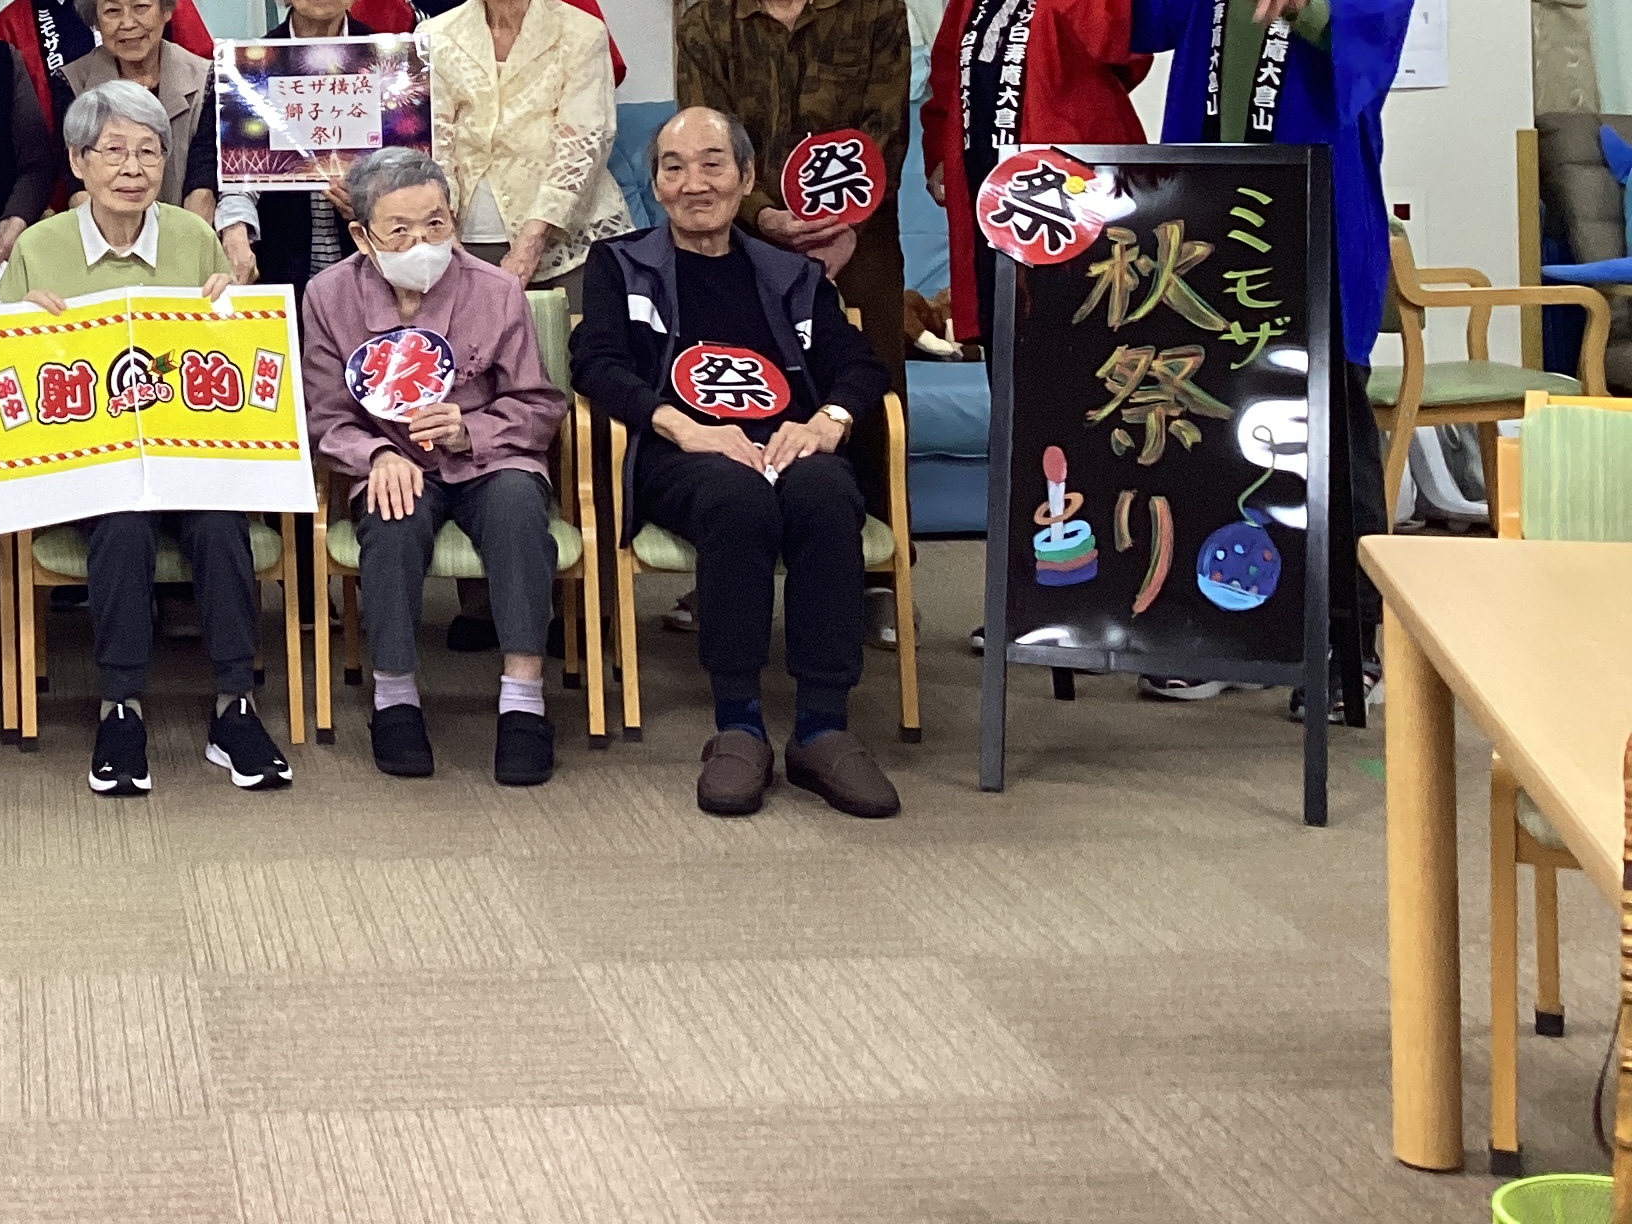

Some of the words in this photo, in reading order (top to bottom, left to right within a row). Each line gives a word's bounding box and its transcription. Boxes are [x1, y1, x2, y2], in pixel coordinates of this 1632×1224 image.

[276, 76, 373, 96] ミモザ横浜
[310, 126, 343, 146] 祭り
[798, 139, 874, 215] 祭
[987, 160, 1079, 255] 祭
[1218, 187, 1292, 370] ミモザ
[254, 355, 278, 402] 的中
[690, 353, 777, 411] 祭
[1072, 219, 1235, 618] 秋祭り
